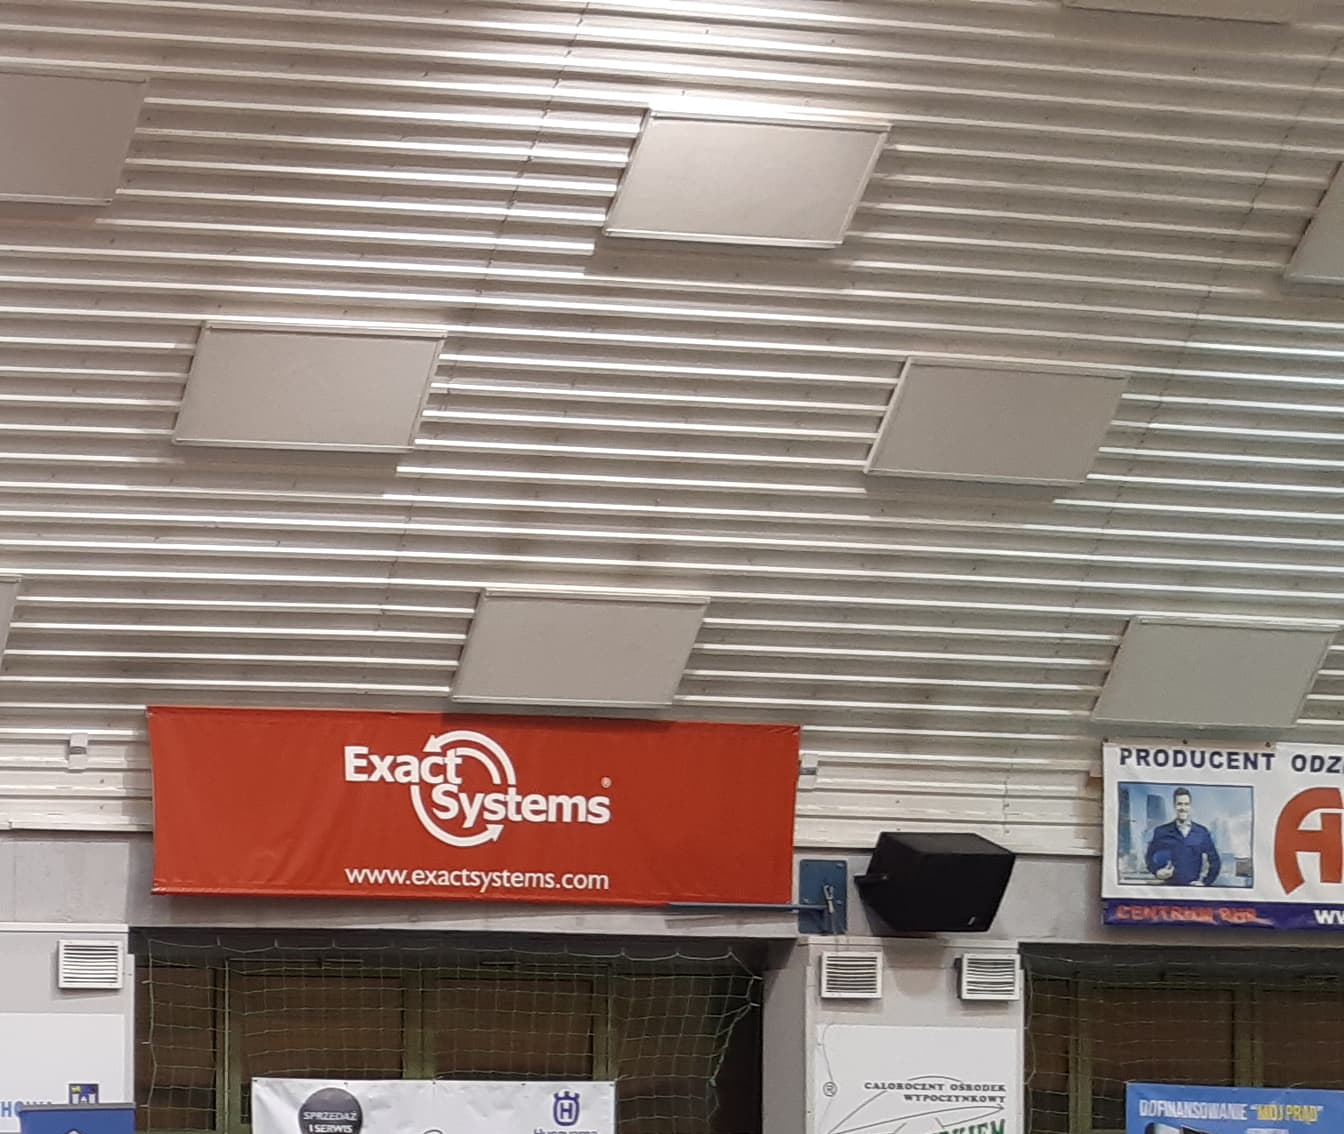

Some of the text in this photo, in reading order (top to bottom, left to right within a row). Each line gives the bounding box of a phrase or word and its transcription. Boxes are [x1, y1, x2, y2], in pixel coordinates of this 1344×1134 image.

[344, 745, 462, 784] Exact
[1119, 747, 1344, 774] PRODUCENT ODZ
[431, 783, 611, 829] Systems
[344, 868, 610, 893] www.exactsystems.com
[949, 1081, 1007, 1092] OŚRODEK
[903, 1093, 1007, 1104] WYPOCZYNKOWY
[303, 1109, 358, 1122] SPRZEDAŻ
[1139, 1099, 1249, 1121] DOFINANSOWANIE
[314, 1123, 353, 1134] SERWIS
